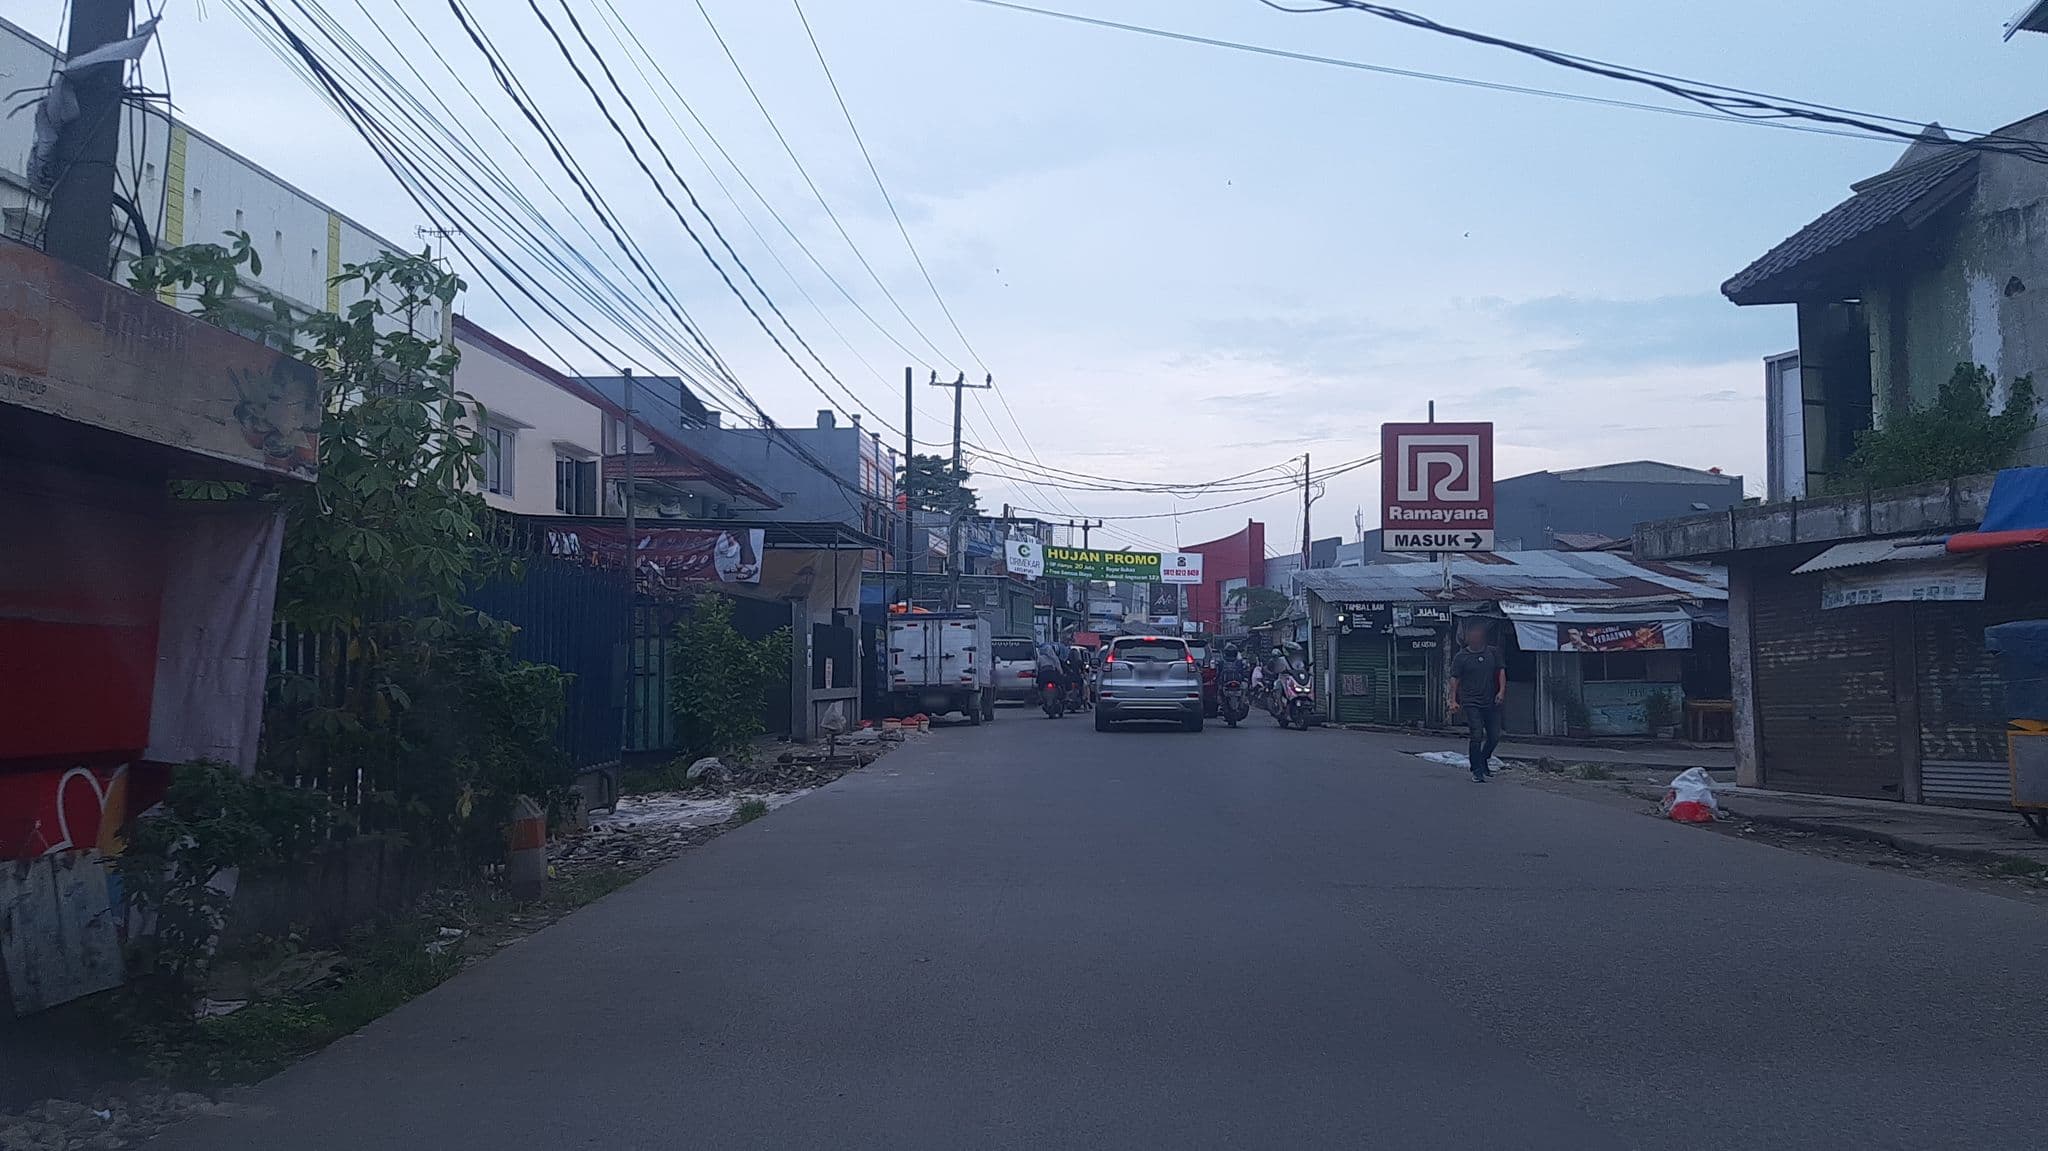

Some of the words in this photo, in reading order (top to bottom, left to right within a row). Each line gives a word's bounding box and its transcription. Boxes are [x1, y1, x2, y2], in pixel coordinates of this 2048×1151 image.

[17, 377, 48, 395] GROUP
[1388, 506, 1488, 522] Ramayana
[1394, 534, 1461, 547] MASUK
[1047, 548, 1101, 562] HUJAN
[1104, 553, 1158, 565] PROMO
[1344, 603, 1371, 612] TAMBAL
